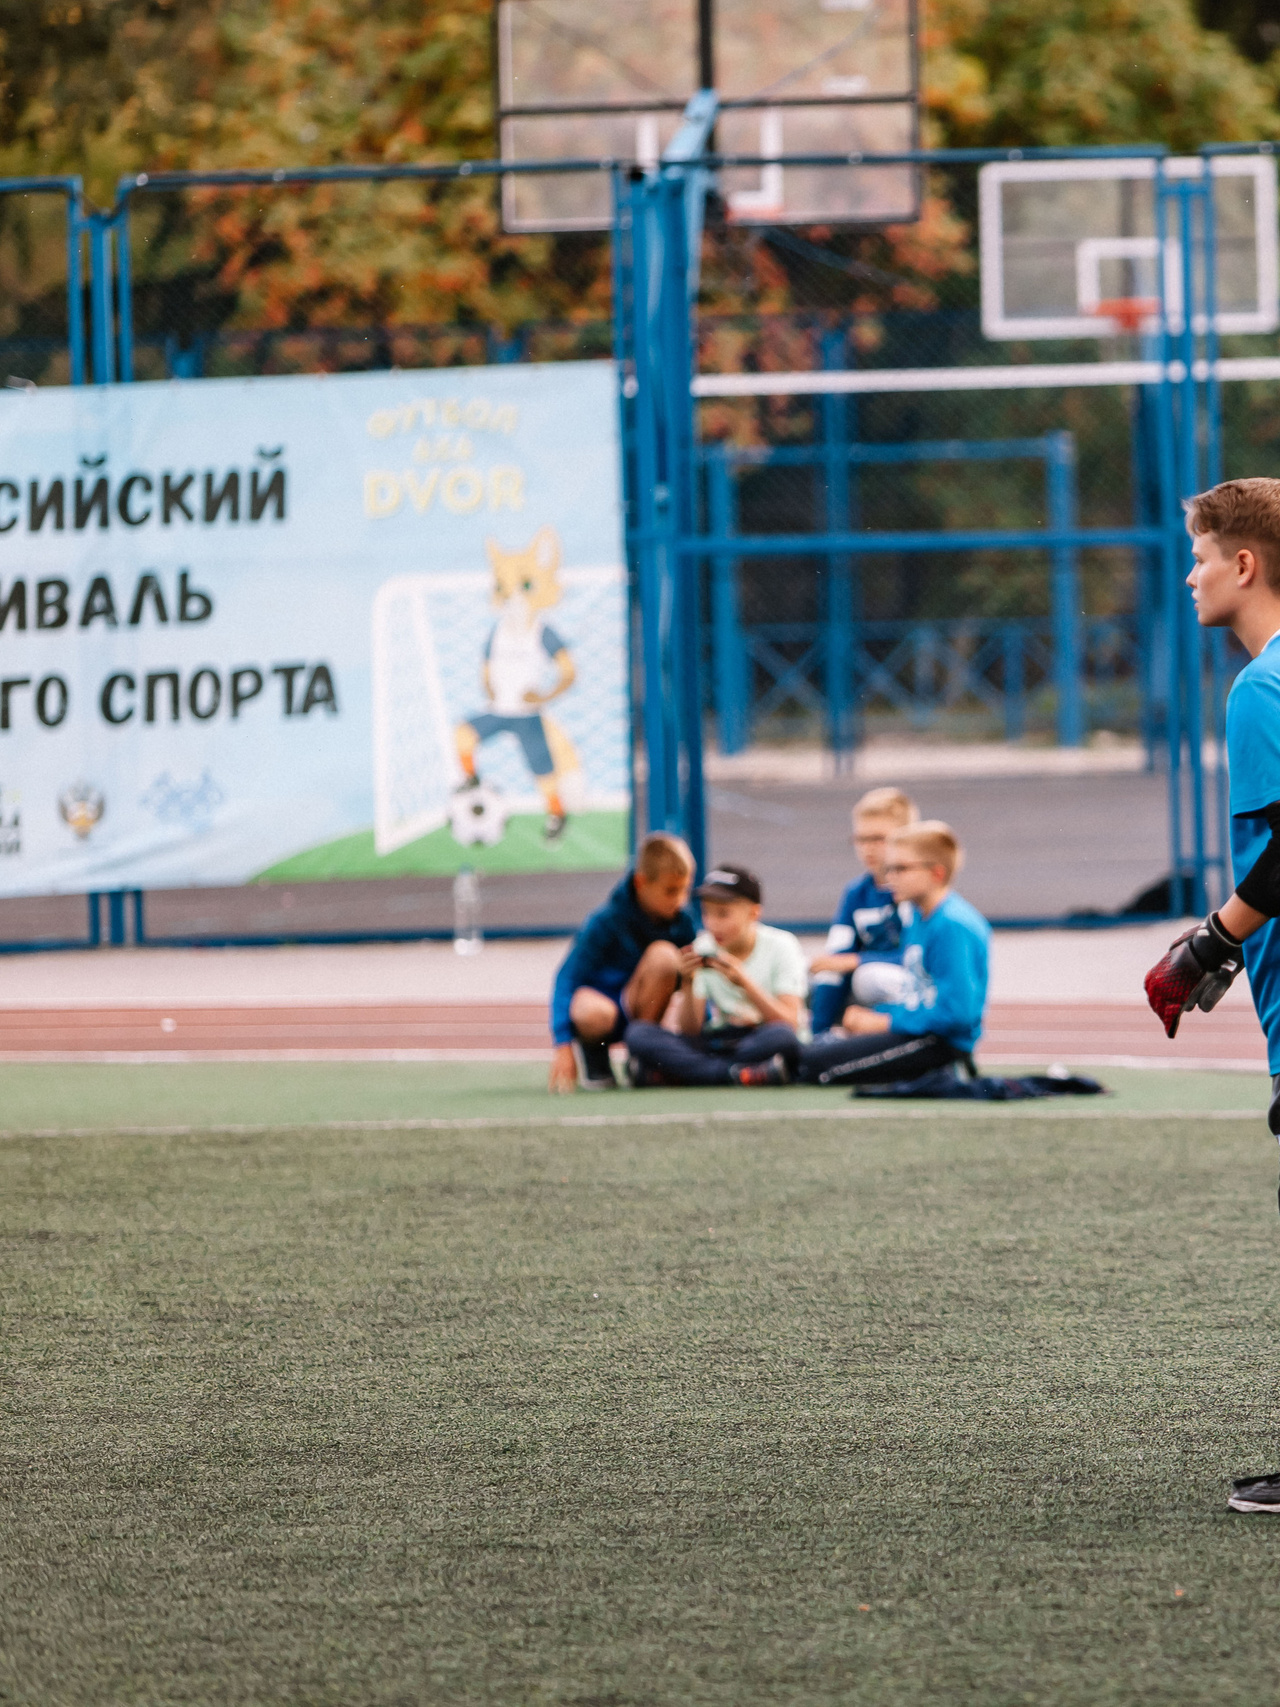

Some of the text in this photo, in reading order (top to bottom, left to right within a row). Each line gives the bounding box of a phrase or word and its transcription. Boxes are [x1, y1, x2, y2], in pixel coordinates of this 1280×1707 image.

[0, 446, 286, 533] СИЙСКИЙ
[363, 465, 526, 519] DVOR
[0, 571, 214, 631] ИВАЛЬ
[0, 665, 339, 730] ГО СПОРТА
